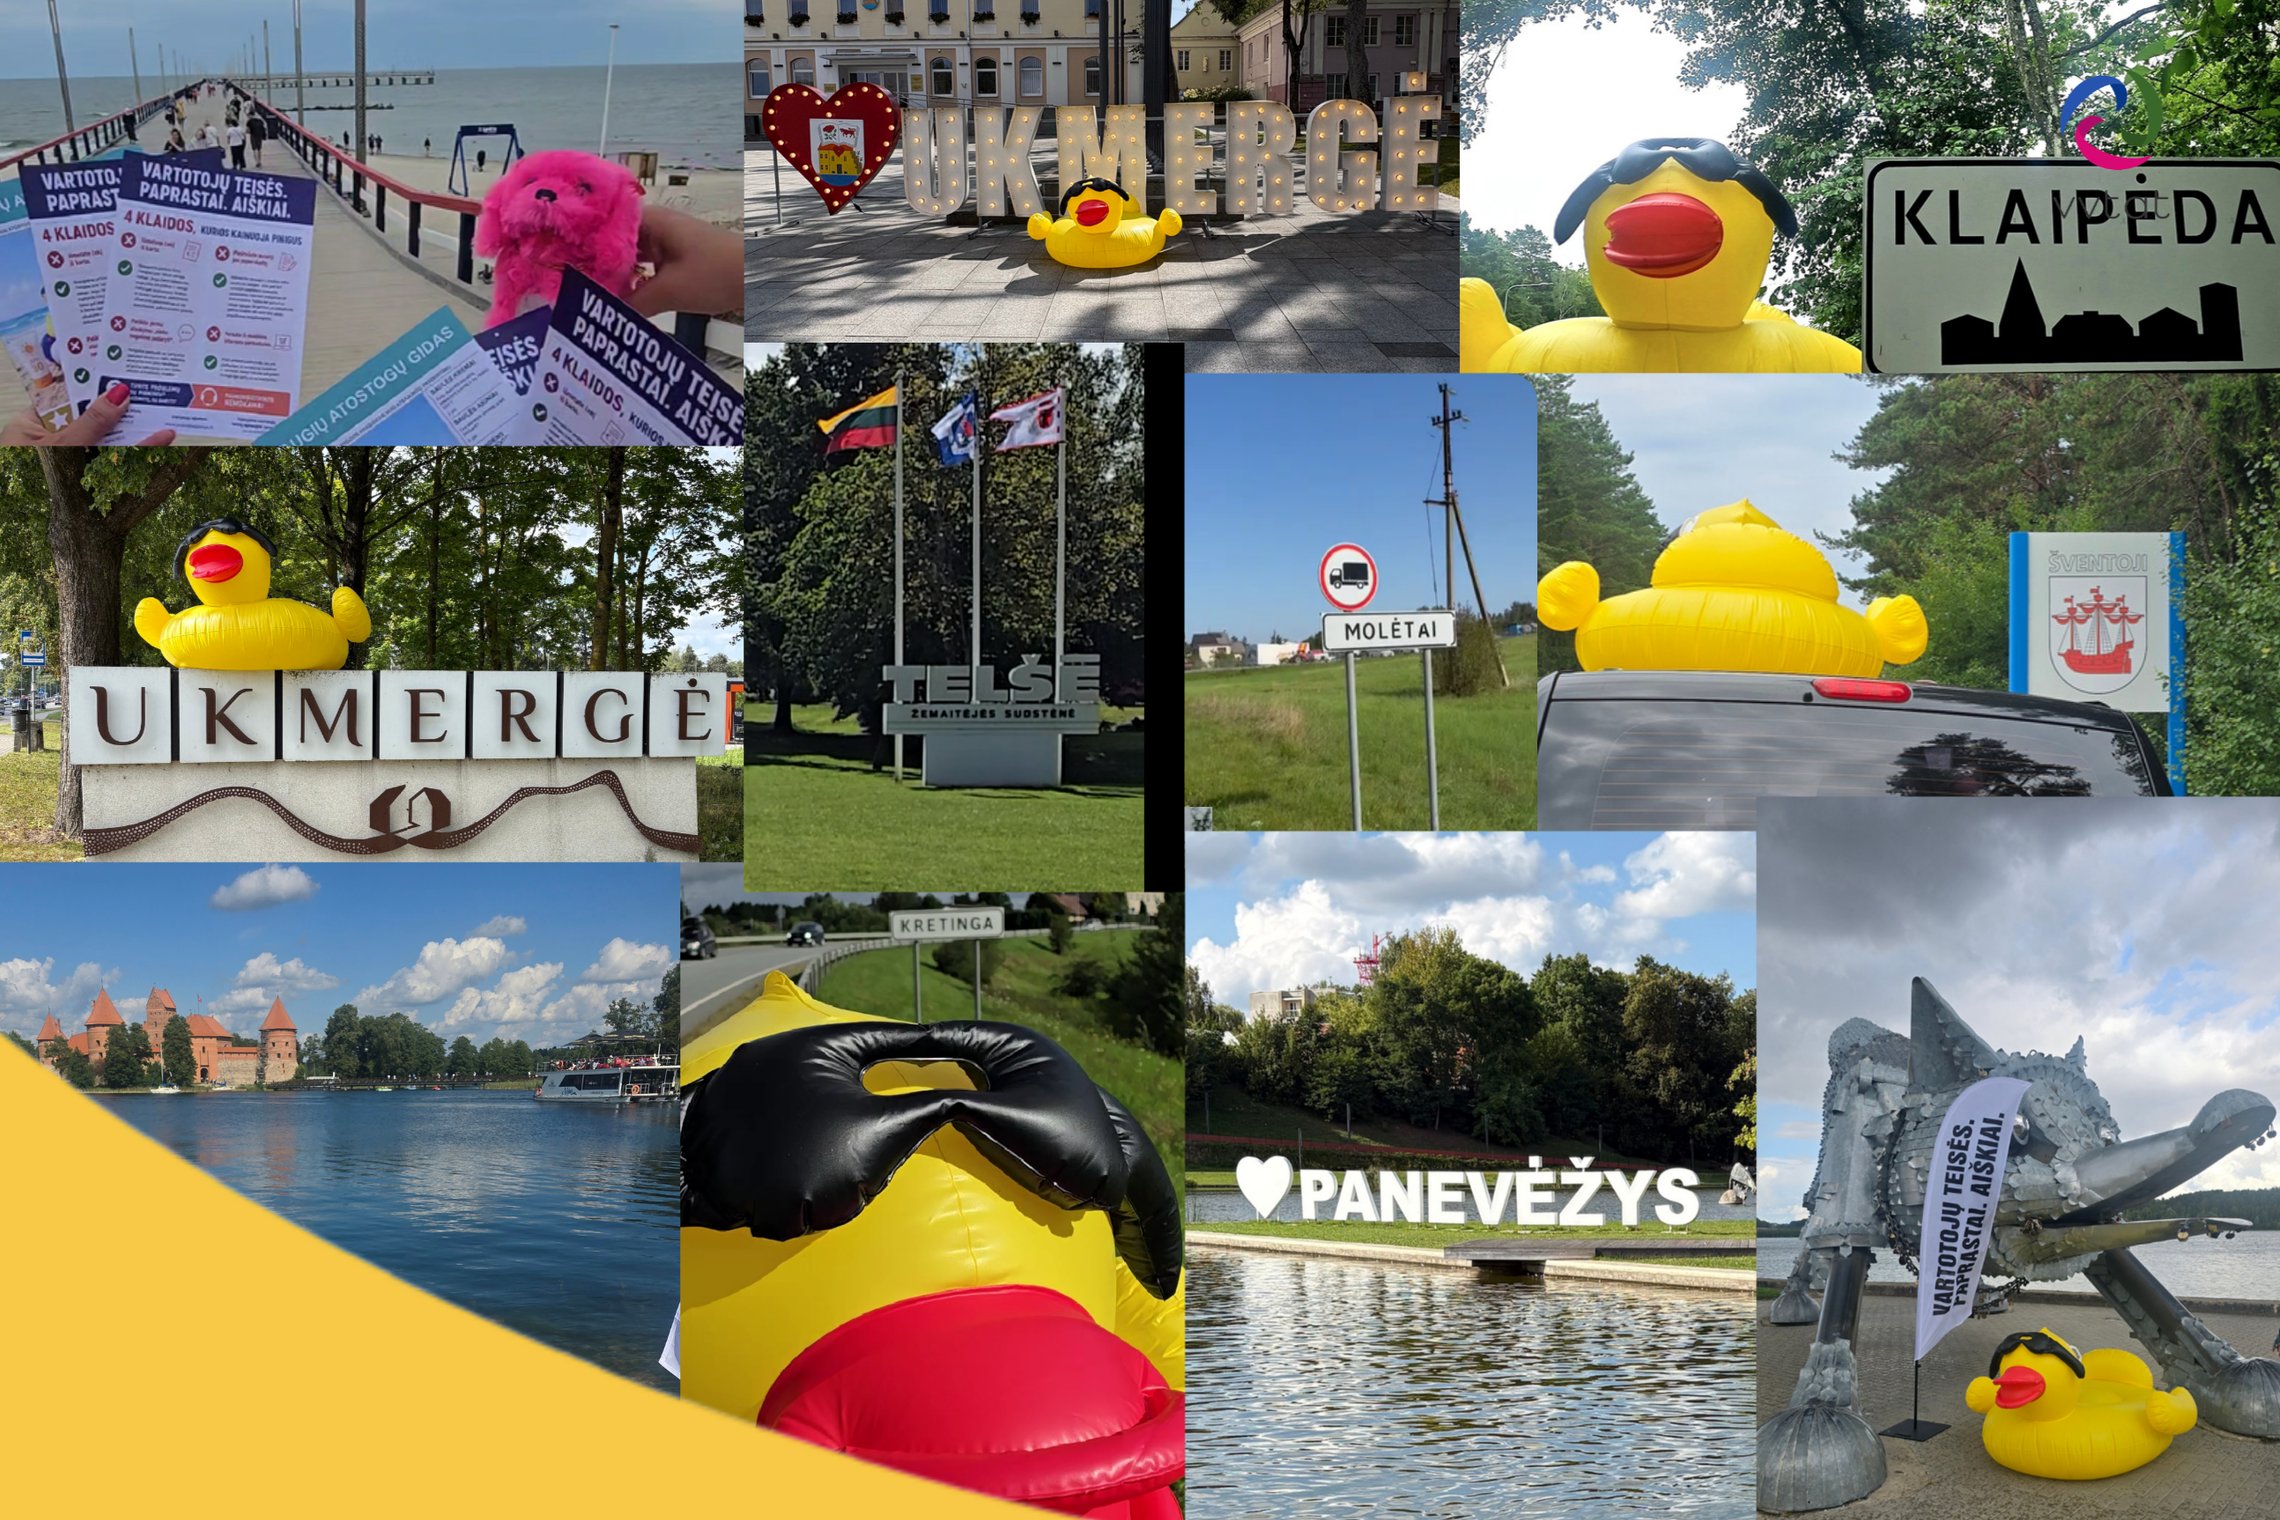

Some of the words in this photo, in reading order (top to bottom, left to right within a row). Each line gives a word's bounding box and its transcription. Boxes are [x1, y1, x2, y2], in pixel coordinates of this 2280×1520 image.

[142, 160, 231, 195] VARTOTOJŲ
[234, 176, 288, 199] TEISĖS.
[902, 71, 1442, 217] UKMERGĖ
[42, 228, 52, 243] 4
[124, 209, 134, 224] 4
[135, 211, 197, 235] KLAIDOS,
[139, 181, 228, 211] PAPRASTAI.
[232, 194, 292, 219] AIŠKIAI.
[1895, 172, 2277, 246] KLAIPĖDA
[281, 417, 329, 446] UGIŲ
[329, 359, 408, 425] ATOSTOGŲ
[408, 325, 455, 364] GIDAS
[551, 346, 561, 363] 4
[562, 353, 625, 418] KLAIDOS,
[572, 315, 672, 411] PAPRASTAI.
[582, 288, 686, 388] VARTOTOJŲ
[686, 370, 744, 440] TEISĖ
[2048, 550, 2148, 573] ŠVENTOJI
[1344, 617, 1436, 641] MOLĖTAI
[90, 678, 712, 747] UKMERGĖ
[901, 916, 993, 933] KRETINGA
[1300, 1155, 1701, 1227] PANEVĖŽYS
[1943, 1119, 1975, 1196] TEISĖS.
[1967, 1112, 2005, 1198] AIŠKIAI.
[1933, 1201, 1965, 1316] VARTOTOJŲ
